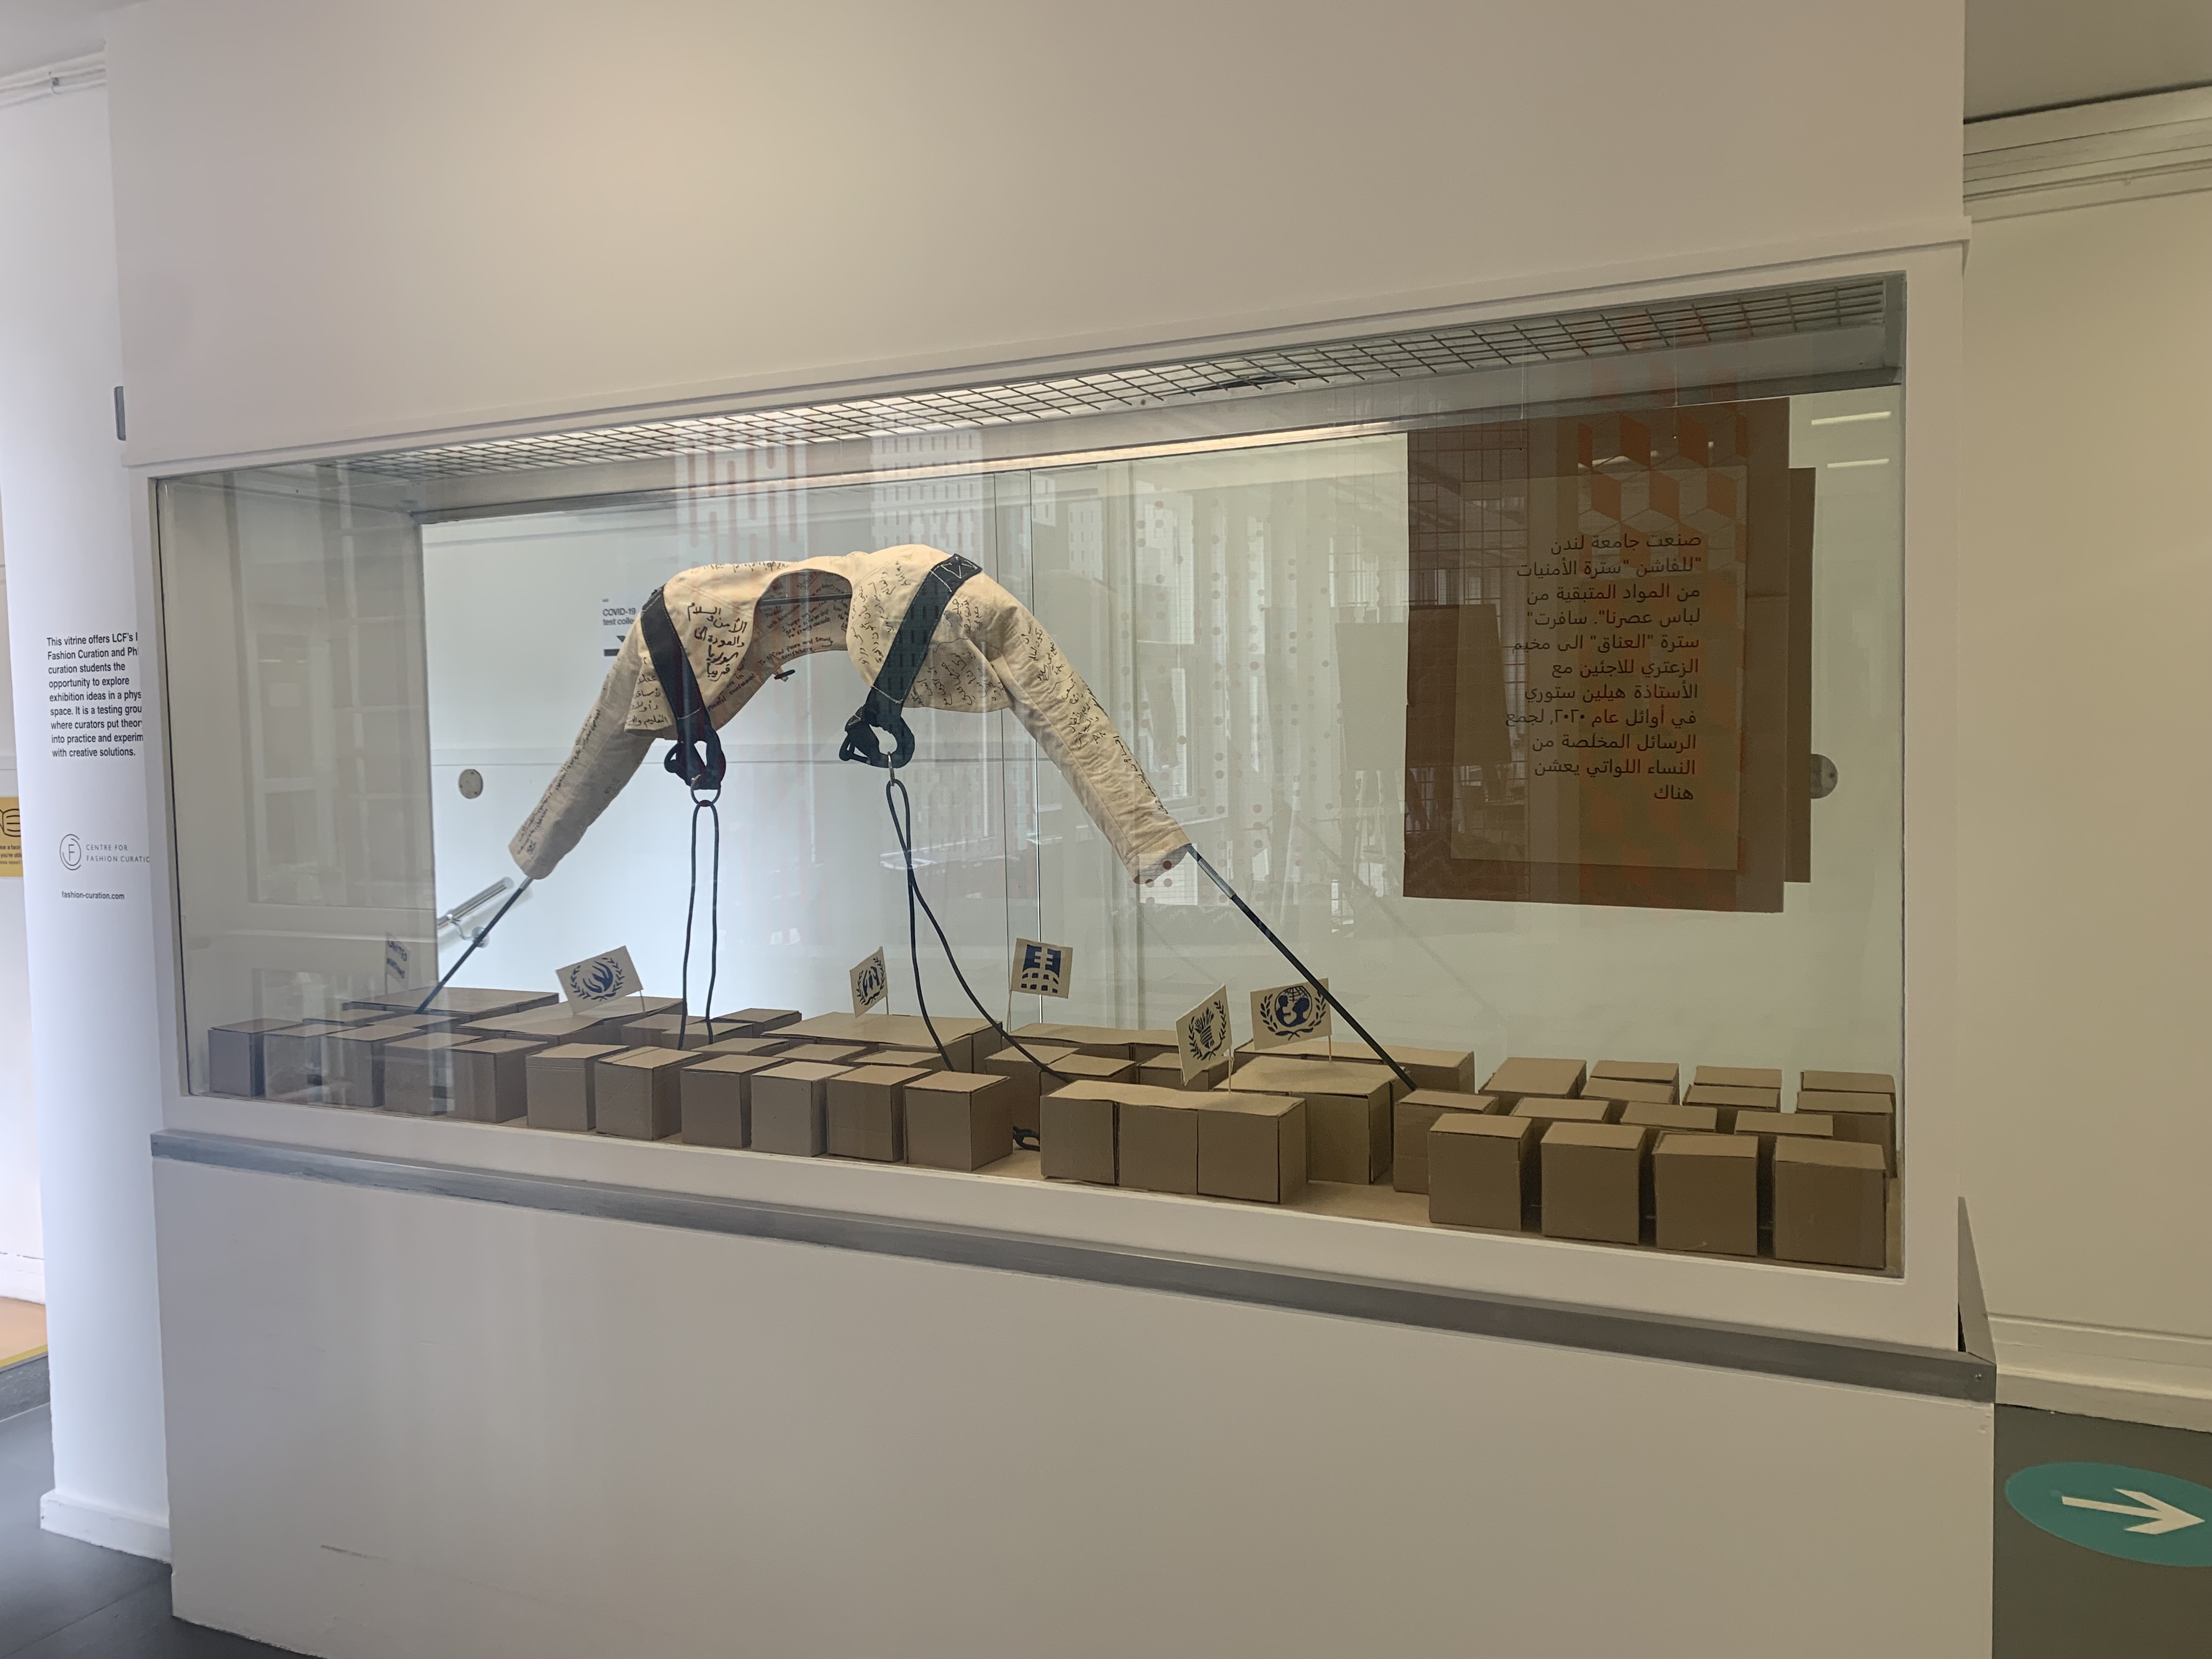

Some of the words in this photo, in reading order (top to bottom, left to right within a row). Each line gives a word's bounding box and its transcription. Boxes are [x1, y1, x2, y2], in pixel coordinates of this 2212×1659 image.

[1551, 535, 1583, 555] لندن
[1592, 533, 1640, 550] جامعة
[1646, 533, 1701, 548] صنعت
[1516, 557, 1577, 579] الأمنيات
[1527, 590, 1549, 605] من
[1556, 584, 1616, 603] المتبقية
[1623, 583, 1669, 602] المواد
[1677, 589, 1700, 601] من
[603, 607, 636, 616] COVID-19
[1660, 608, 1700, 627] لباس
[47, 637, 62, 646] This
[64, 636, 87, 645] vitrine
[88, 635, 110, 644] offers
[112, 633, 133, 643] LCF's
[1513, 639, 1550, 653] مخيم
[1661, 634, 1699, 652] سترة
[48, 651, 76, 660] Fashion
[78, 649, 109, 658] Curation
[111, 647, 125, 657] and
[48, 664, 77, 674] curation
[80, 663, 111, 673] students
[114, 662, 126, 671] the
[1552, 664, 1573, 678] مع
[1580, 659, 1634, 678] للاجئين
[1641, 658, 1699, 678] الزعتري
[49, 678, 90, 690] opportunity
[92, 677, 100, 686] to
[102, 676, 129, 687] explore
[1634, 680, 1697, 698] الأستاذة
[49, 693, 84, 702] exhibition
[87, 692, 106, 701] ideas
[108, 691, 115, 699] in
[124, 690, 142, 701] phys
[1525, 687, 1575, 702] ستوري
[1583, 684, 1626, 703] هيلين
[50, 707, 74, 718] space.
[75, 706, 80, 715] It
[82, 706, 88, 715] is
[97, 705, 122, 715] testing
[125, 706, 142, 715] grou
[1506, 709, 1544, 727] لجمع
[1592, 709, 1619, 727] عام
[1626, 704, 1664, 728] أوائل
[1671, 710, 1696, 729] في
[50, 720, 72, 729] where
[75, 720, 104, 729] curators
[107, 720, 119, 730] put
[51, 735, 65, 743] into
[67, 734, 96, 745] practice
[98, 733, 111, 742] and
[1532, 738, 1554, 752] من
[1562, 732, 1630, 749] المخلصة
[1637, 734, 1696, 753] الرسائل
[52, 748, 67, 757] with
[69, 748, 98, 757] creative
[100, 747, 136, 757] solutions.
[1535, 760, 1579, 776] يعشن
[1587, 759, 1640, 777] اللواتي
[1647, 759, 1695, 775] النساء
[1654, 785, 1694, 800] هناك
[61, 891, 125, 900] fashion-curation.com
